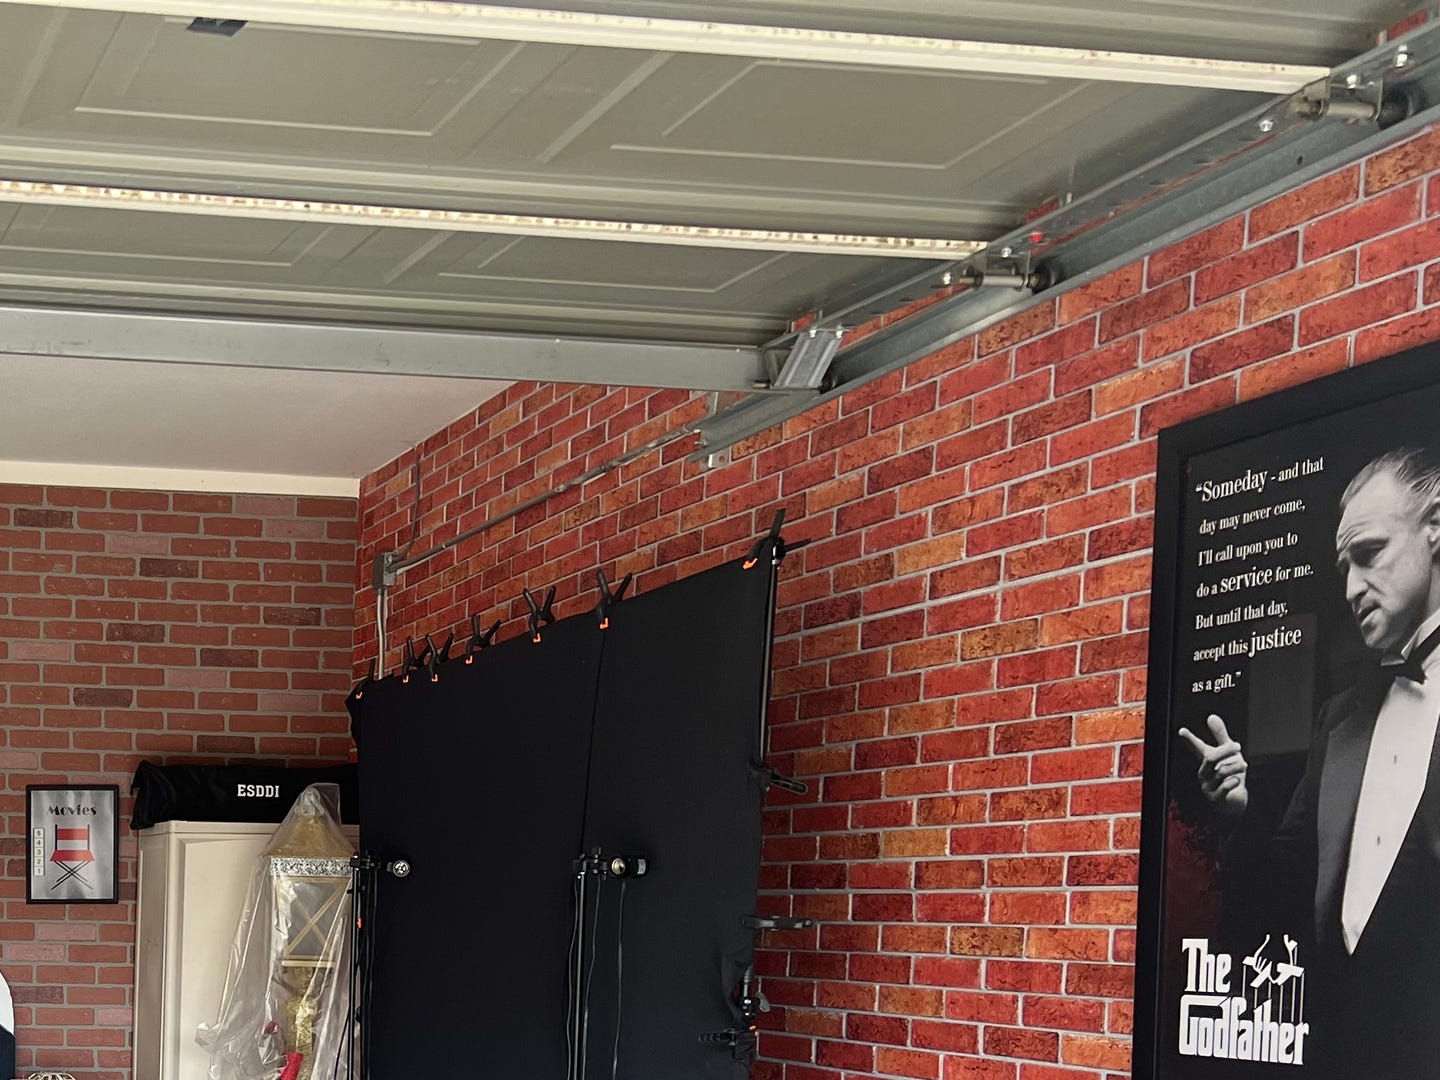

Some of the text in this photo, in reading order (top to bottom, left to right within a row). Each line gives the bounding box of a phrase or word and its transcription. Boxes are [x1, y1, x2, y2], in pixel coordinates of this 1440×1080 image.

[1195, 469, 1268, 502] “Someday
[1278, 462, 1299, 482] and
[1302, 457, 1325, 475] that
[1199, 499, 1306, 535] day may never come,
[1198, 531, 1298, 567] I'll call upon you to
[1196, 564, 1314, 598] do a service for me.
[1195, 600, 1288, 630] But until that day,
[1193, 626, 1302, 662] accept this justice
[1192, 681, 1204, 693] as
[1206, 679, 1212, 691] a
[237, 784, 280, 798] ESDDI
[48, 804, 97, 816] Movies
[1181, 938, 1232, 993] The
[1178, 994, 1310, 1065] Godfather
